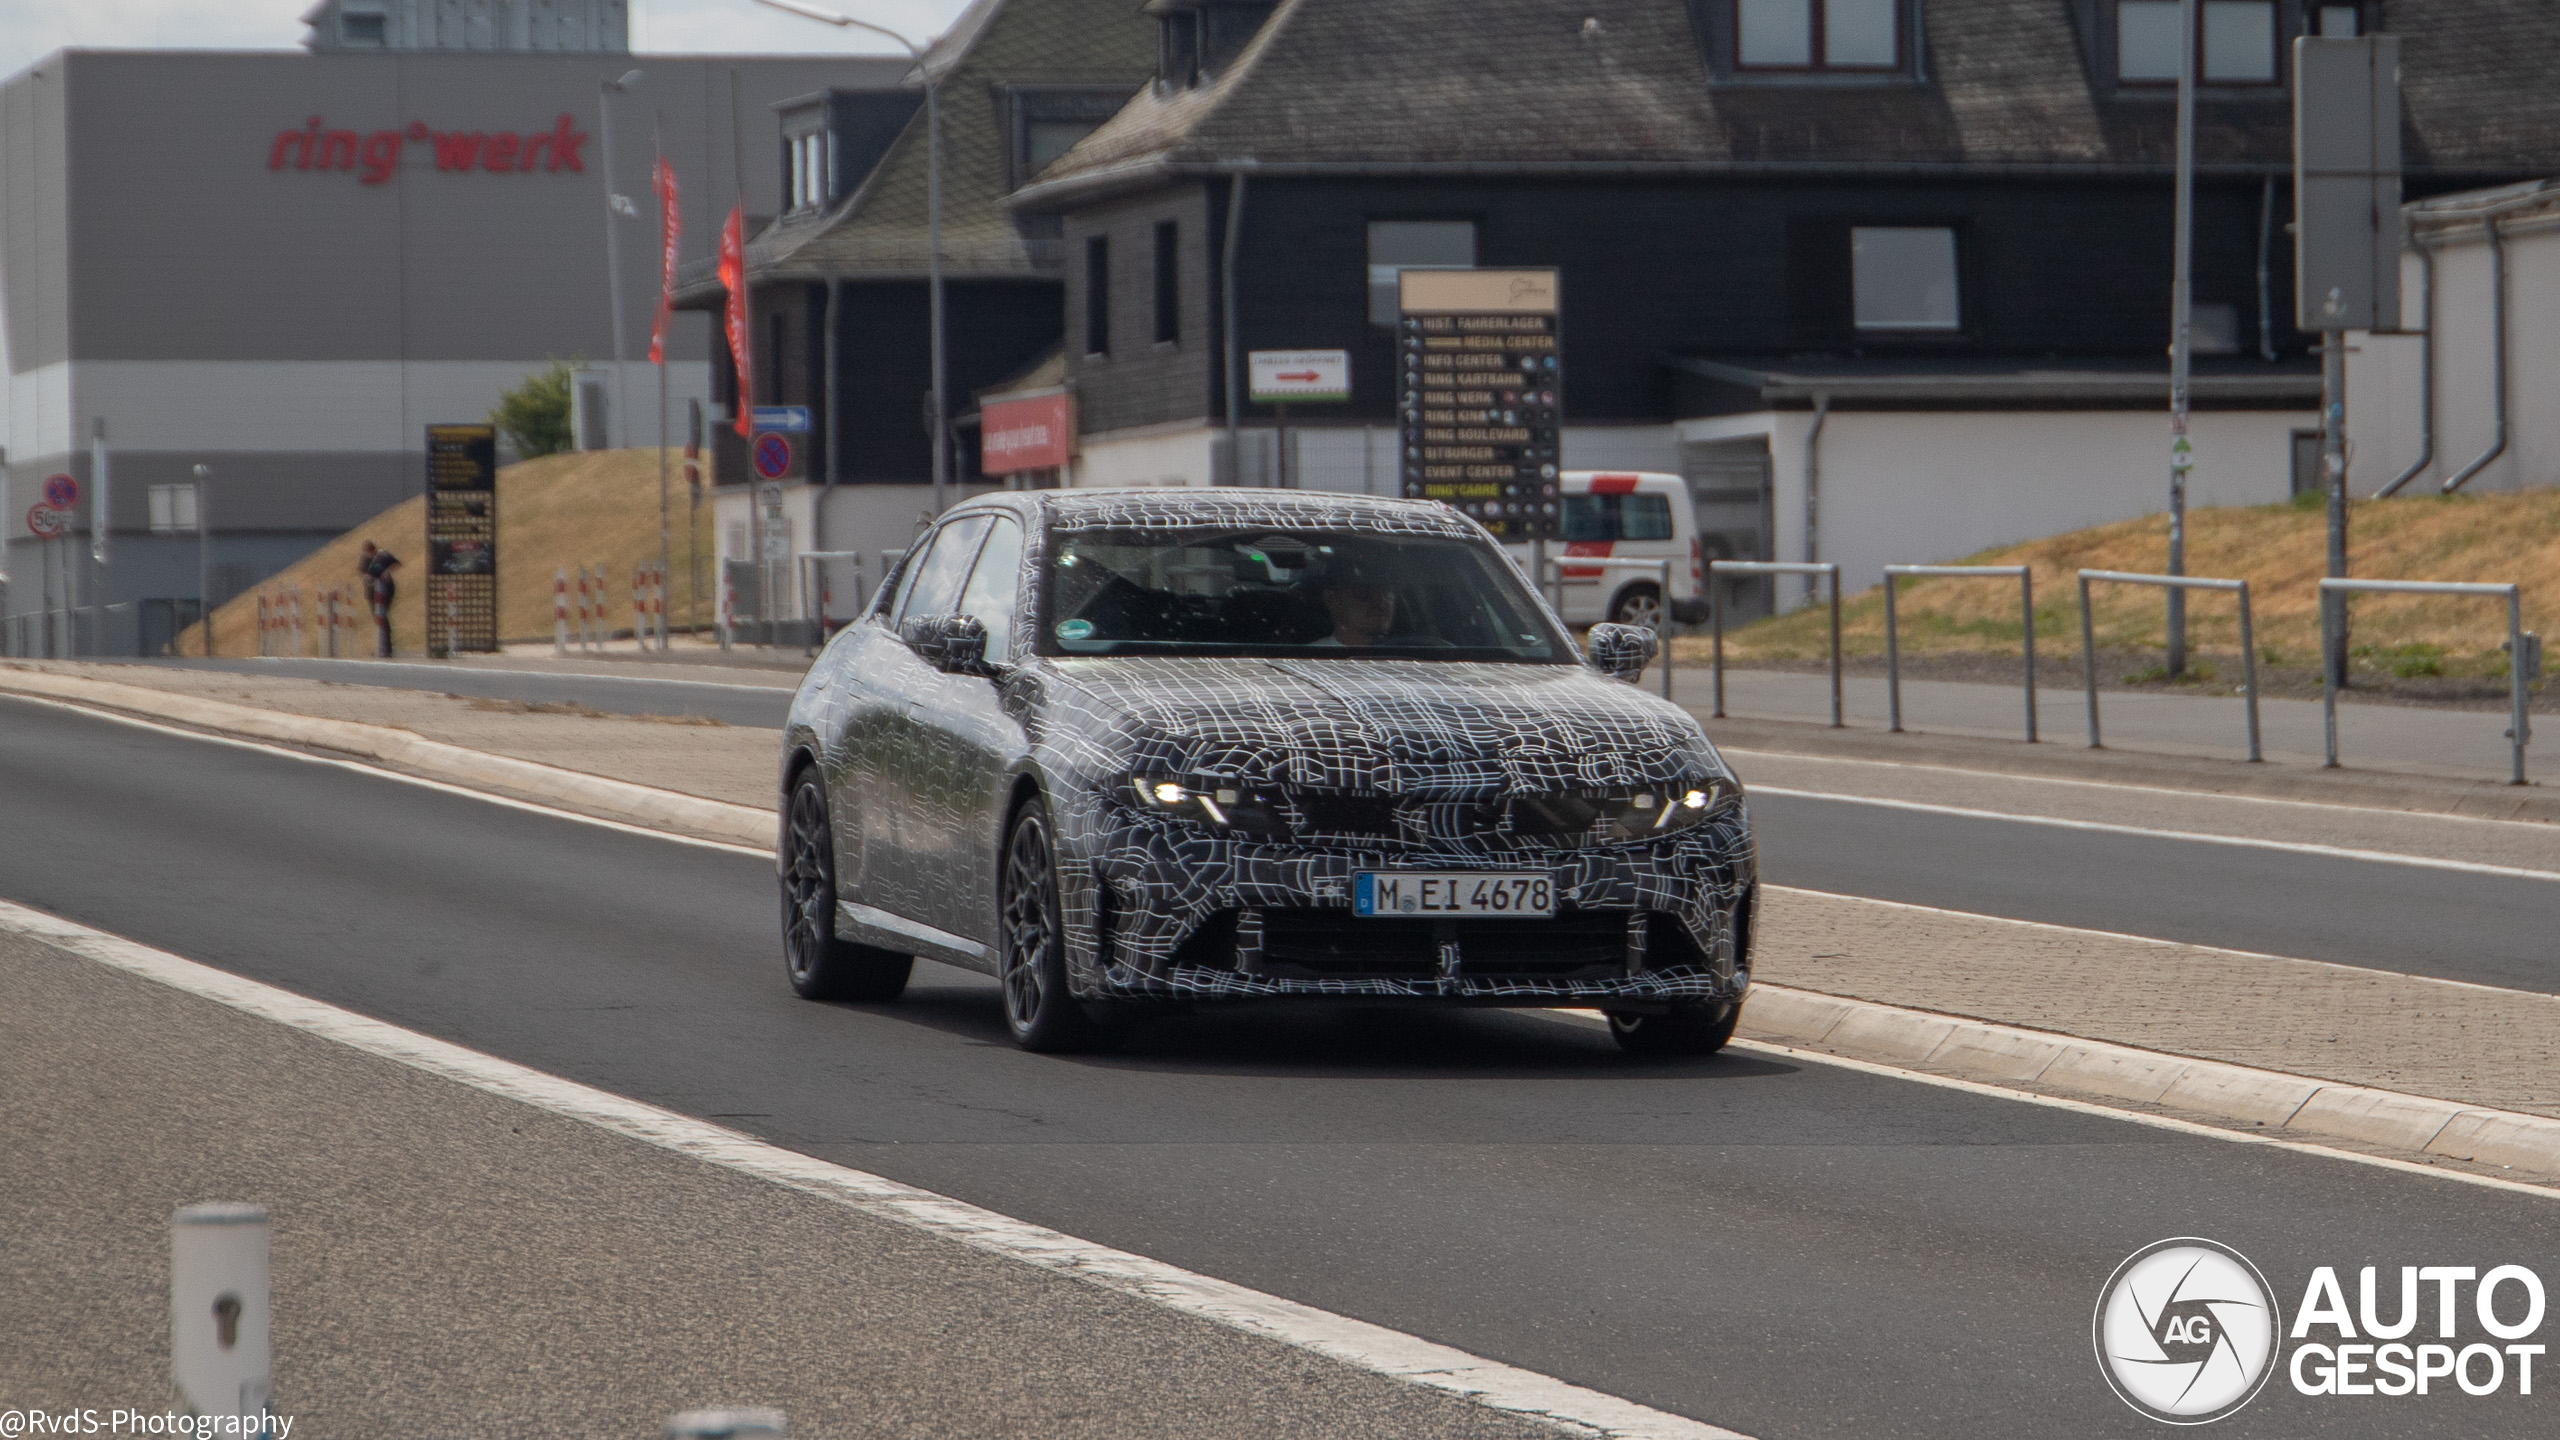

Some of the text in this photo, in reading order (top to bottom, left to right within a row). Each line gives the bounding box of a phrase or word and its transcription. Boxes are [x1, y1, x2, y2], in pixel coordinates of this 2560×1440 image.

[1457, 317, 1543, 329] FAHRERLAGER
[1464, 336, 1554, 348] MEDIA CENTER
[1423, 354, 1501, 365] INFO CENTER
[1424, 373, 1523, 384] RING KARTBAHN
[1424, 391, 1493, 403] RING WERK
[1424, 410, 1453, 422] RING
[1424, 428, 1529, 440] RING BOULEVARD
[1424, 447, 1493, 459] BITBURGER
[1425, 465, 1514, 477] EVENT CENTER
[1360, 898, 1368, 908] D
[1377, 878, 1399, 910] M
[1470, 879, 1550, 910] 4678
